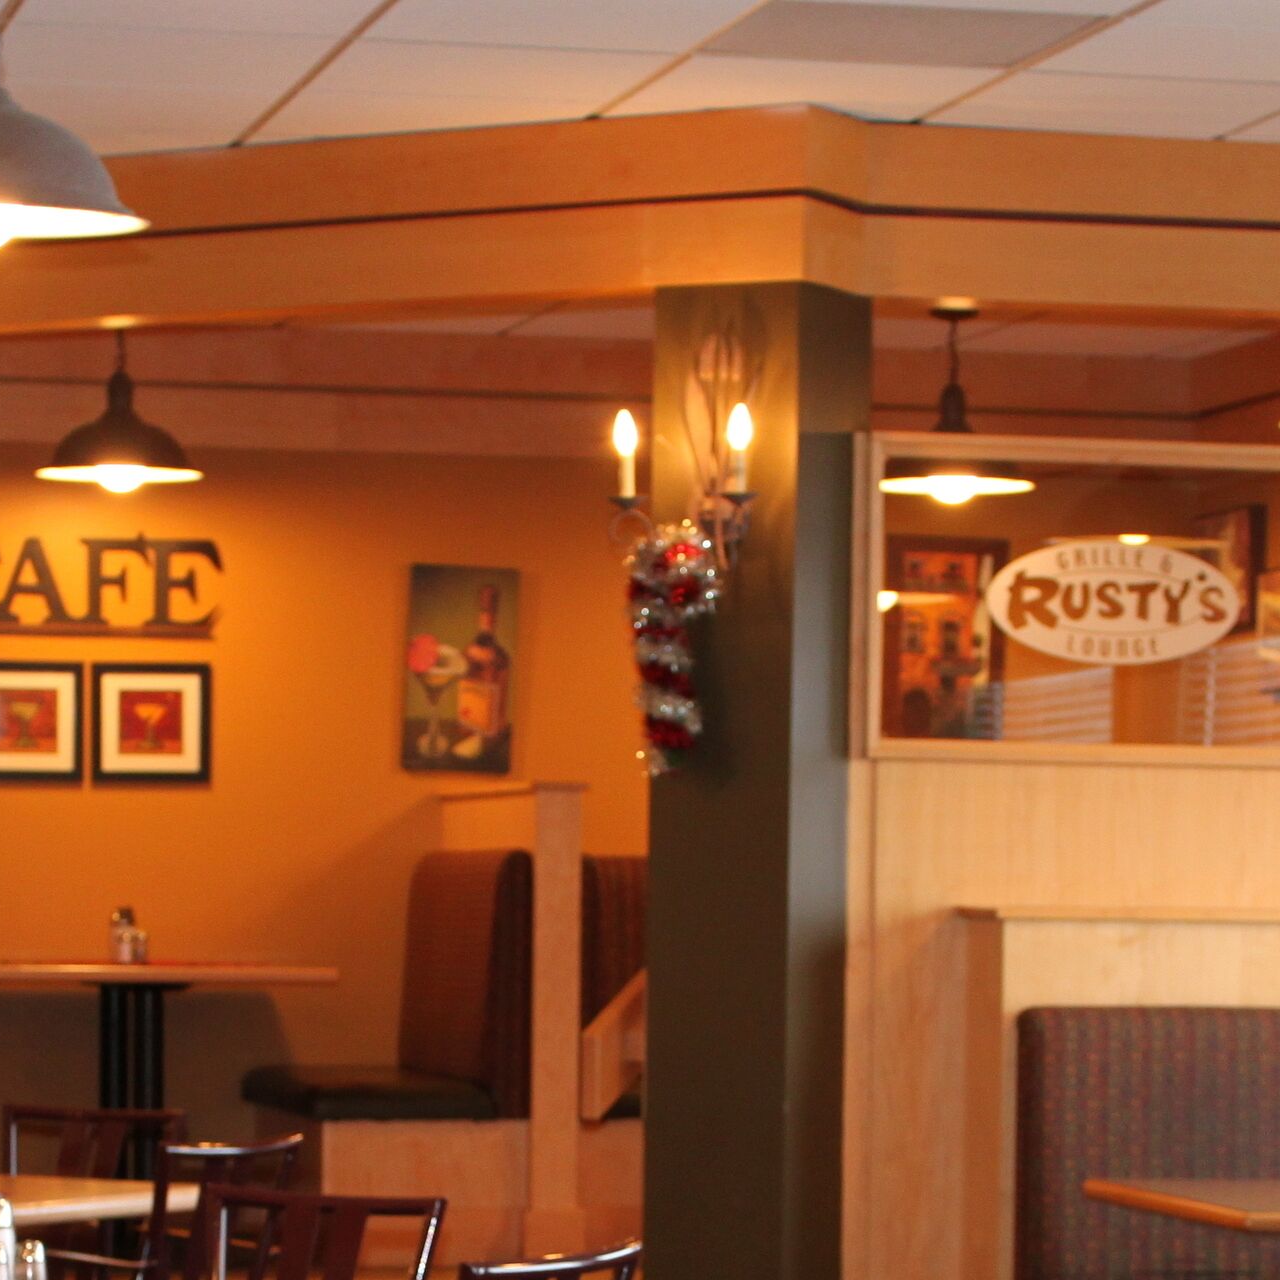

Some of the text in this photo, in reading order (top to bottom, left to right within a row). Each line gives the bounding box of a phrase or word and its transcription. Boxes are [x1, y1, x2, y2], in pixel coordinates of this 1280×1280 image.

[1056, 548, 1145, 571] GRILLE
[1007, 569, 1227, 630] RUSTY'S
[1066, 634, 1159, 657] LOUNGE
